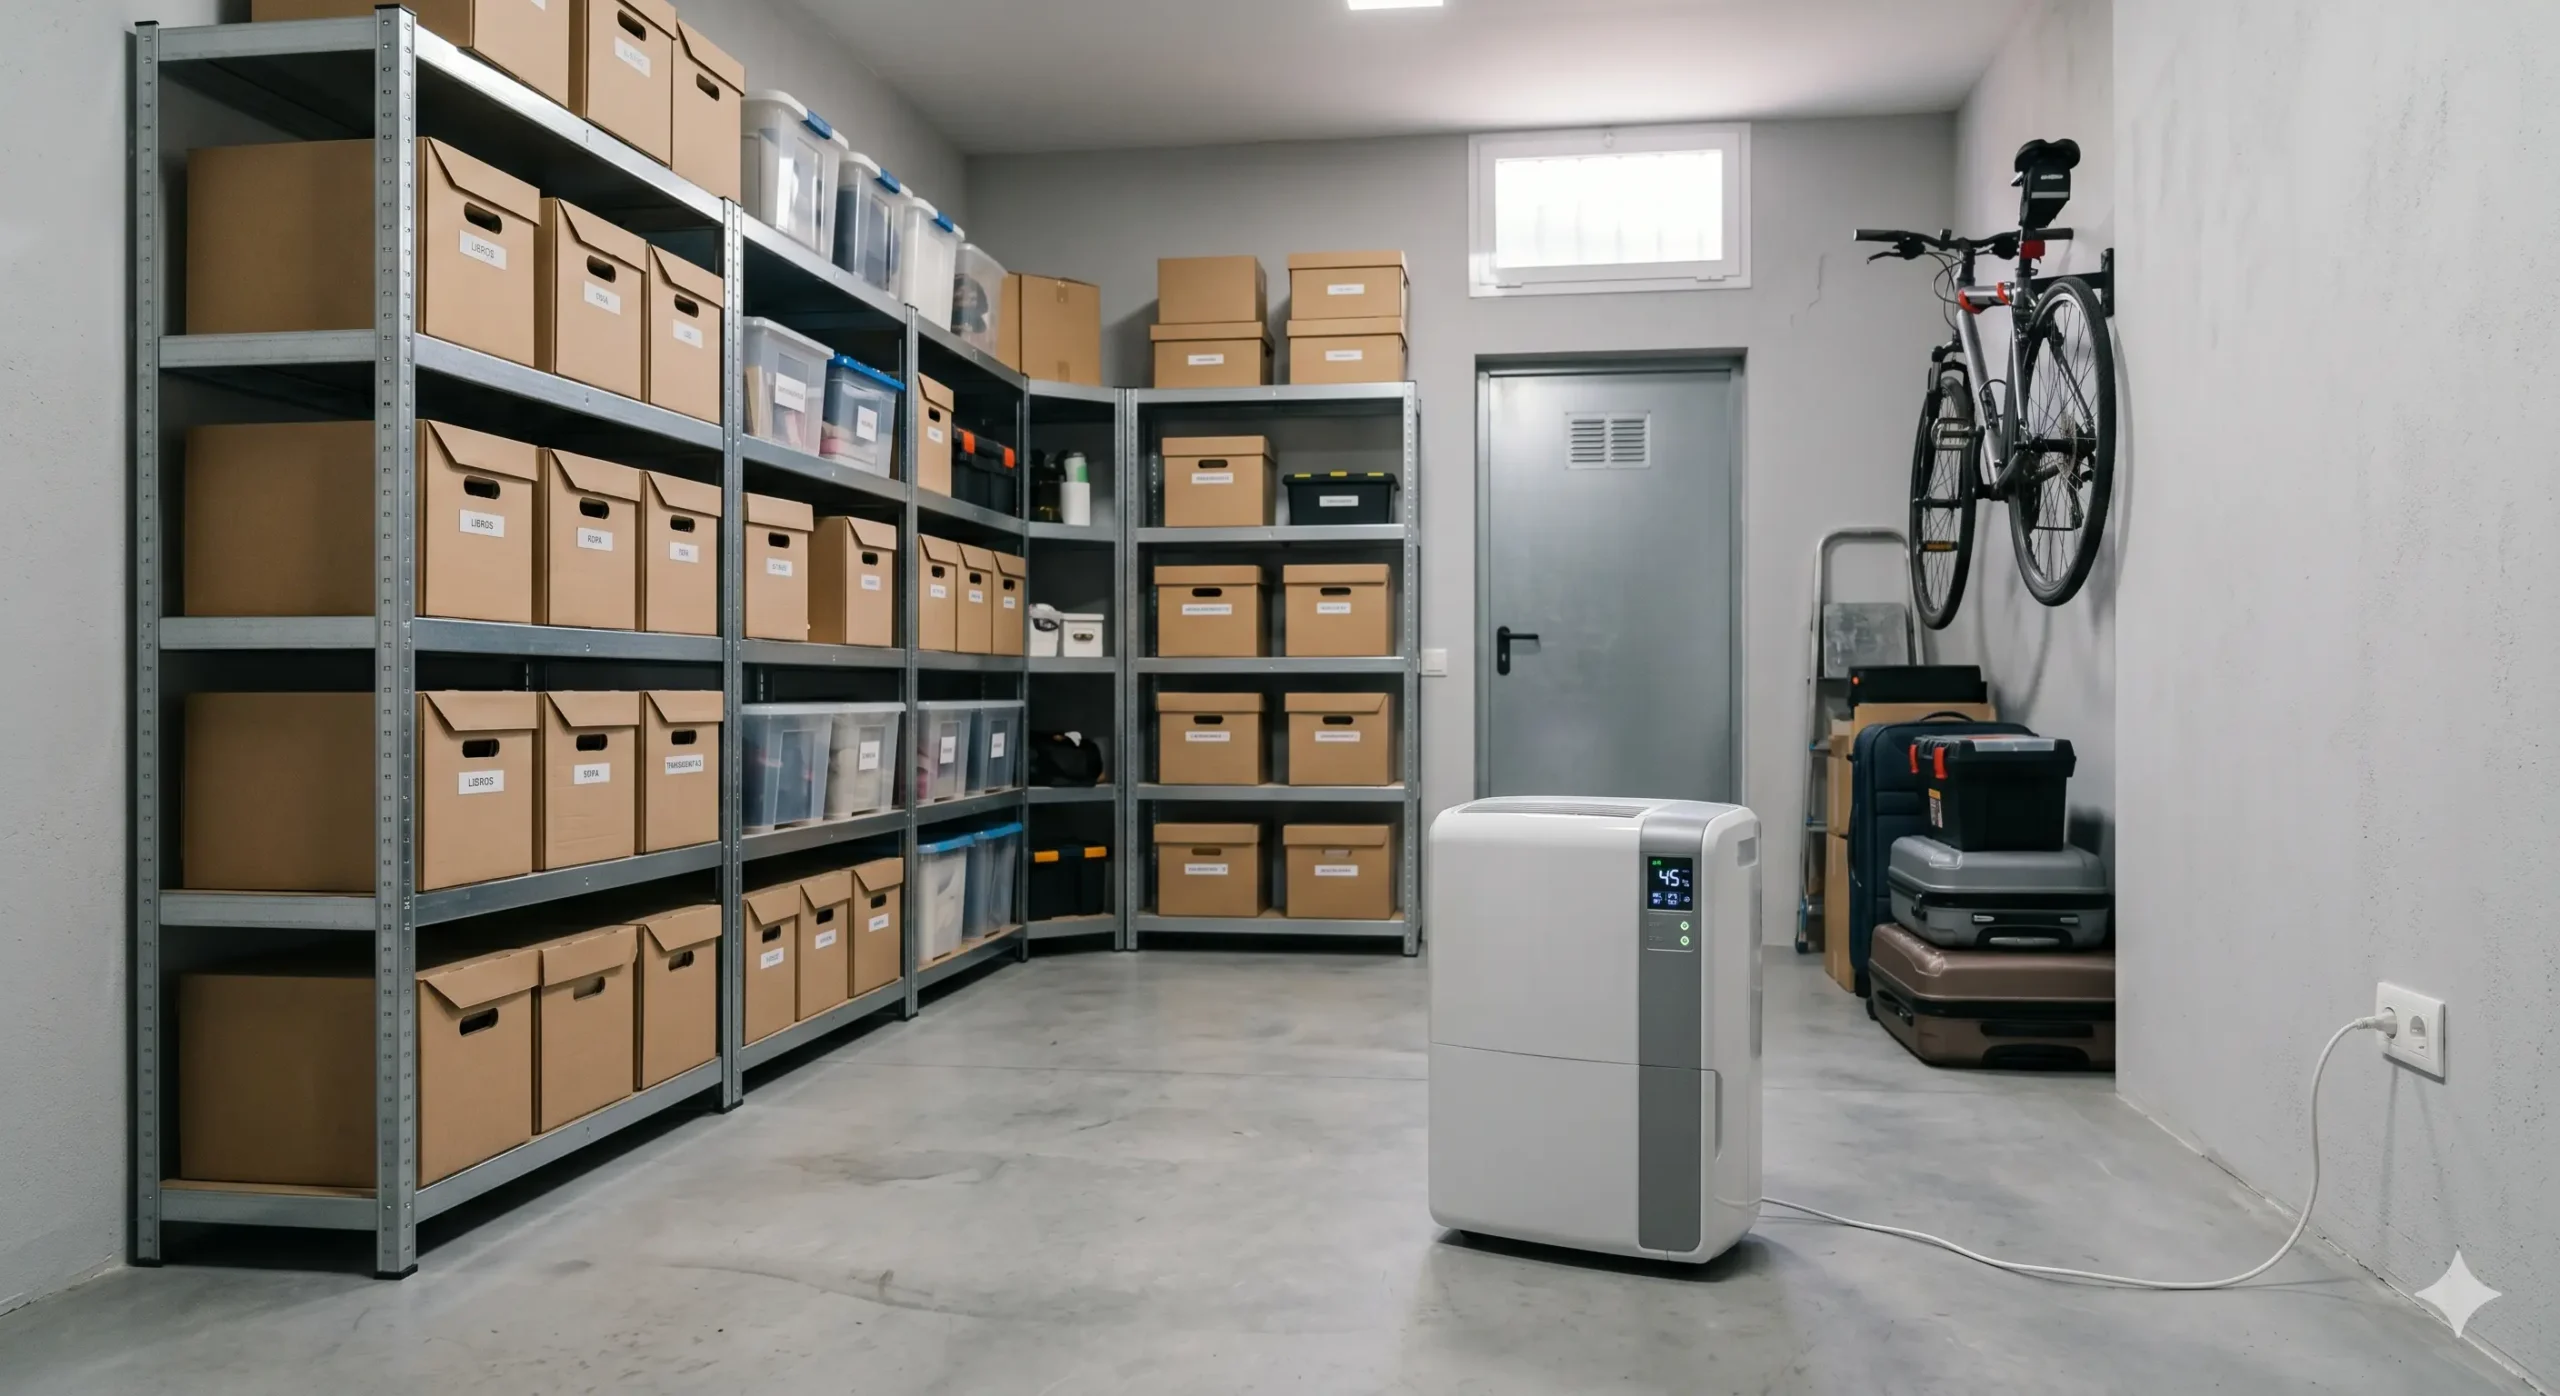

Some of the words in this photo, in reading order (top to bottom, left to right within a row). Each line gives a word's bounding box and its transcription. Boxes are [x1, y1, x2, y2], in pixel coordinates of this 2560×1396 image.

[471, 241, 495, 259] LIBROS
[471, 518, 494, 530] LIBROS
[1659, 869, 1680, 887] 45
